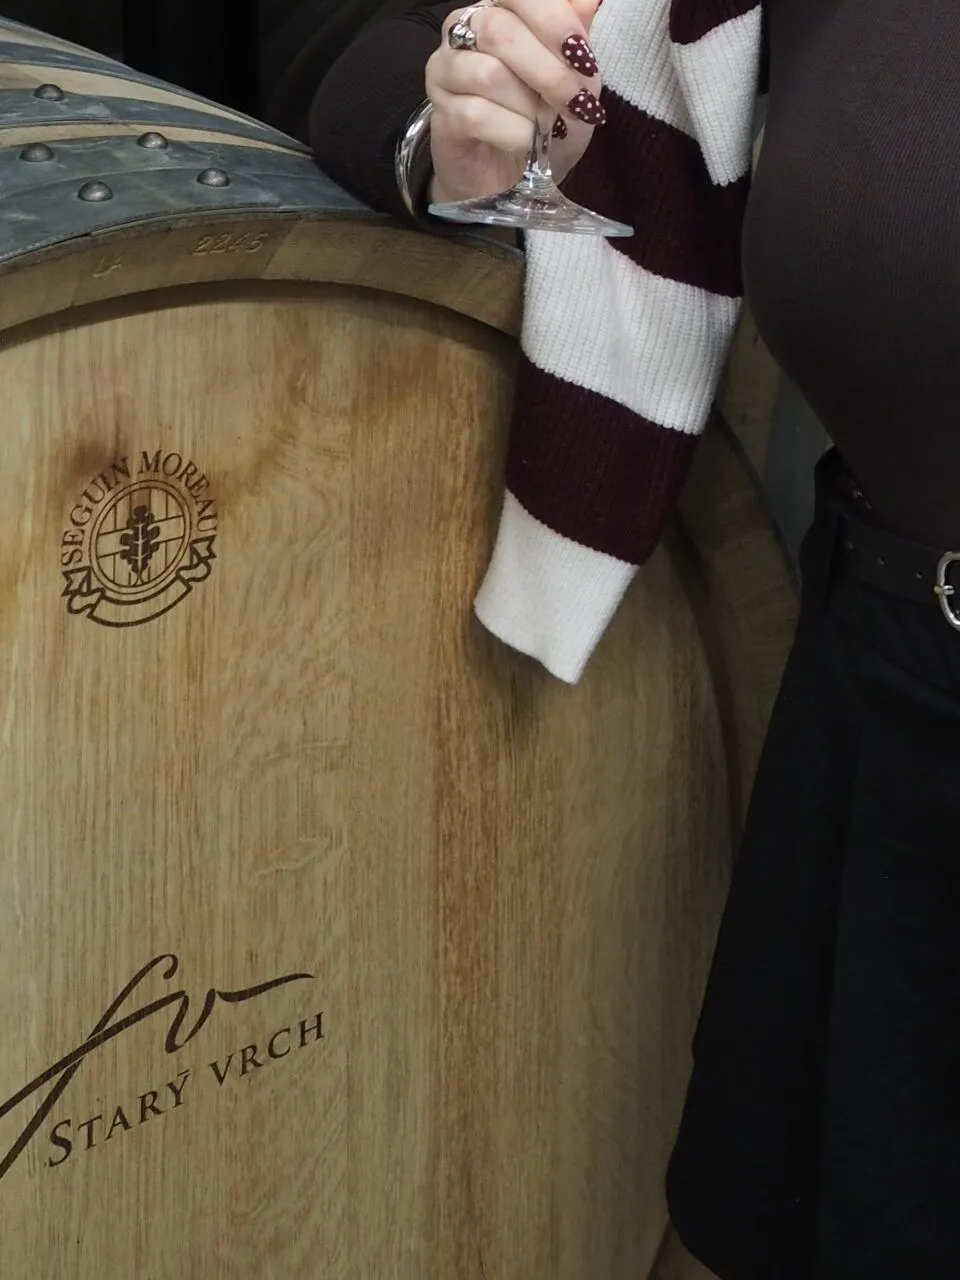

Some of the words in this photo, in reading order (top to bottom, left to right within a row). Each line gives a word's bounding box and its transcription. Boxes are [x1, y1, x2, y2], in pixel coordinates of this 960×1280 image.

[60, 456, 132, 567] SEGUIN
[138, 449, 218, 534] MOREAU
[208, 1011, 325, 1087] VRCH
